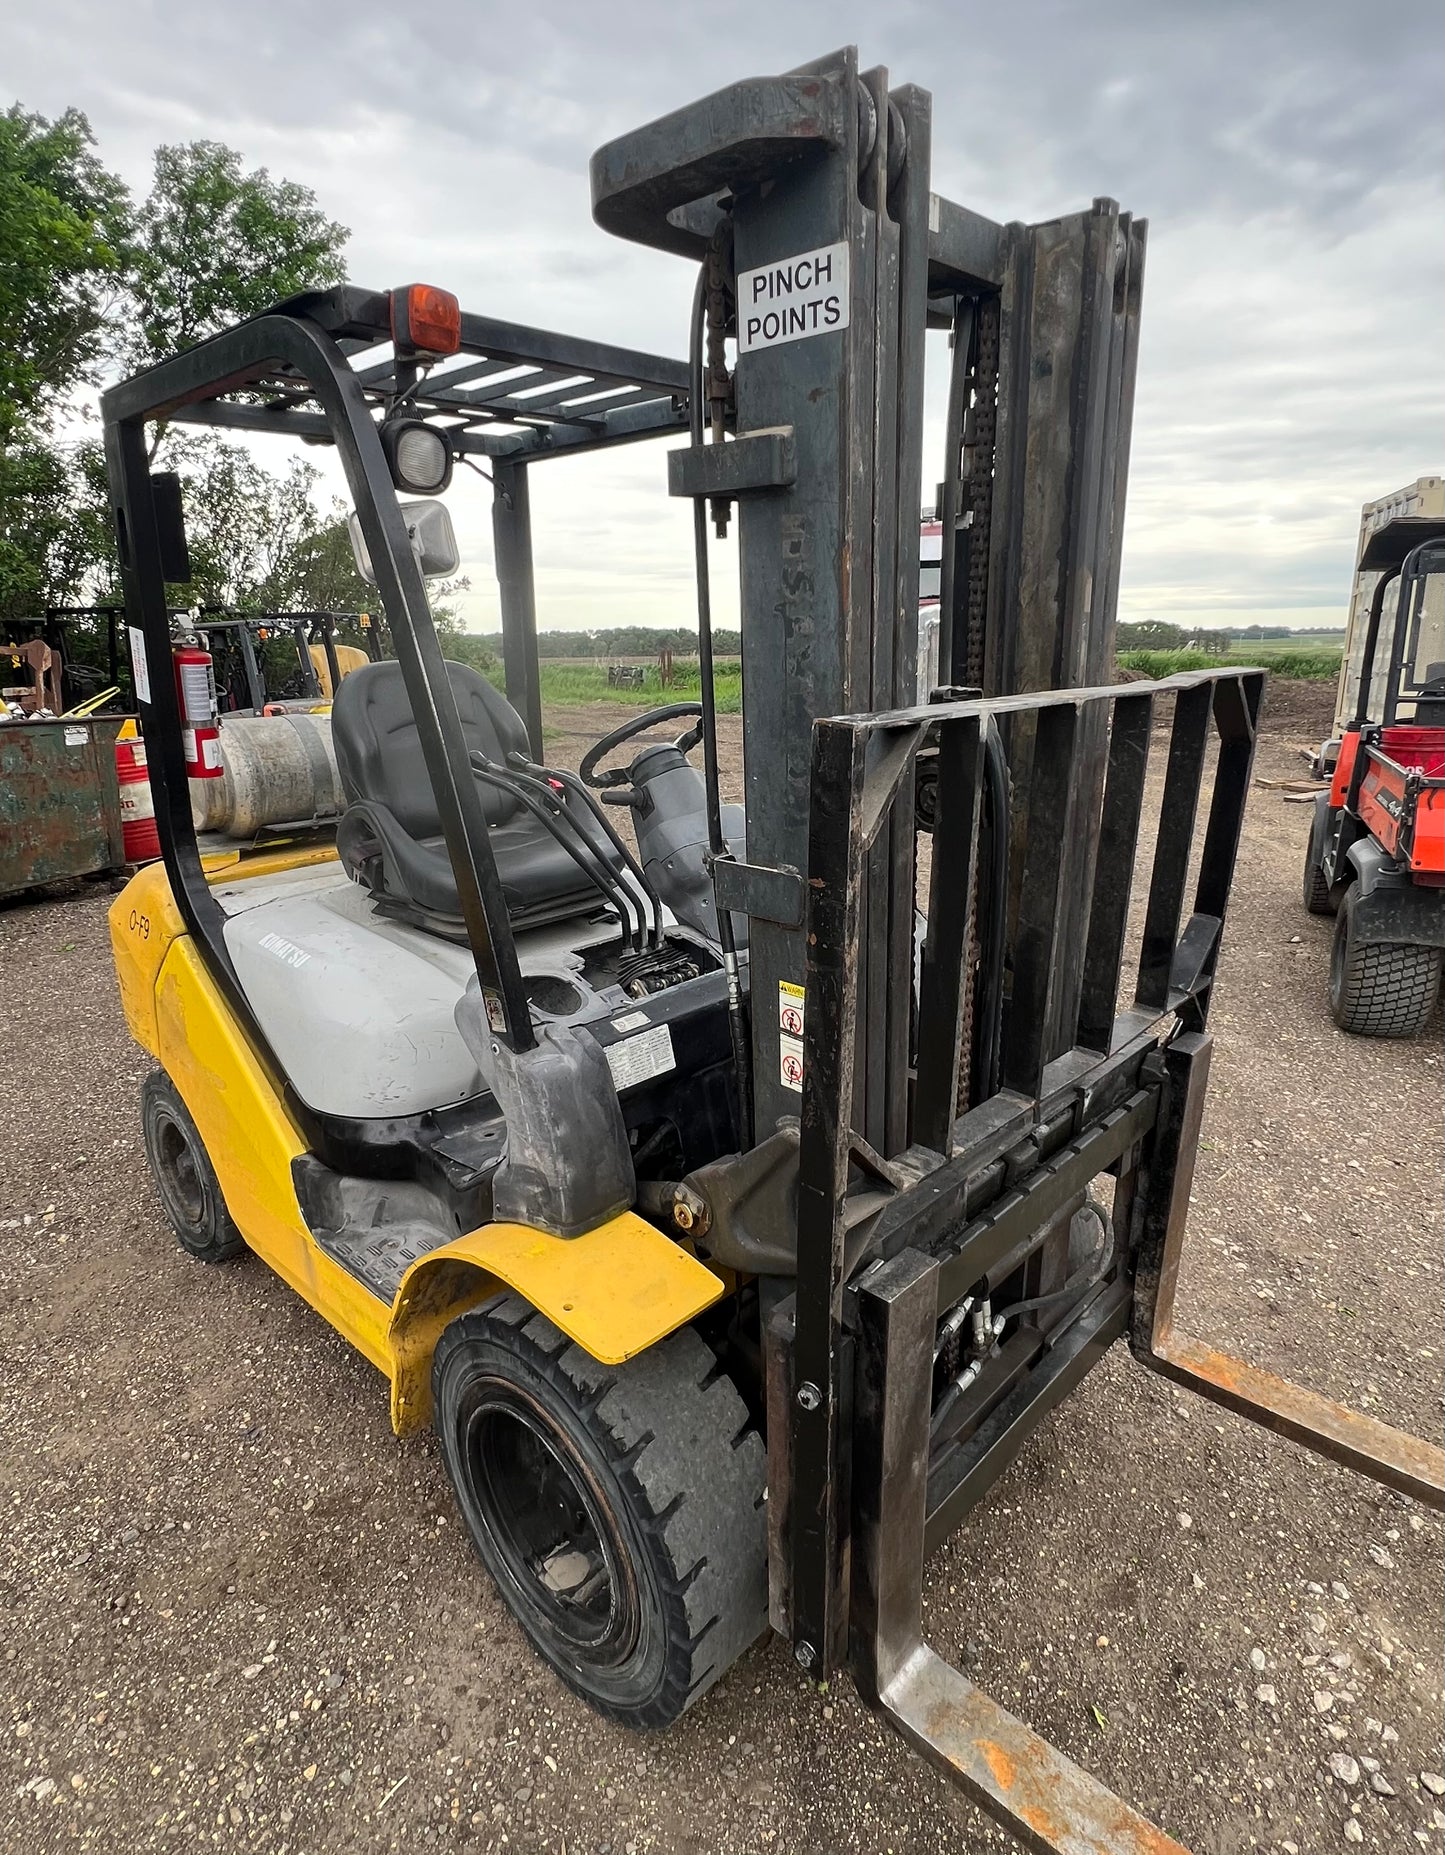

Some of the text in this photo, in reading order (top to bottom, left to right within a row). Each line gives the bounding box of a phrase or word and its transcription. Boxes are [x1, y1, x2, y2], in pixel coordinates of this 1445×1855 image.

[752, 253, 832, 304] PINCH
[747, 295, 840, 345] POINTS
[257, 931, 312, 969] KOMATSU
